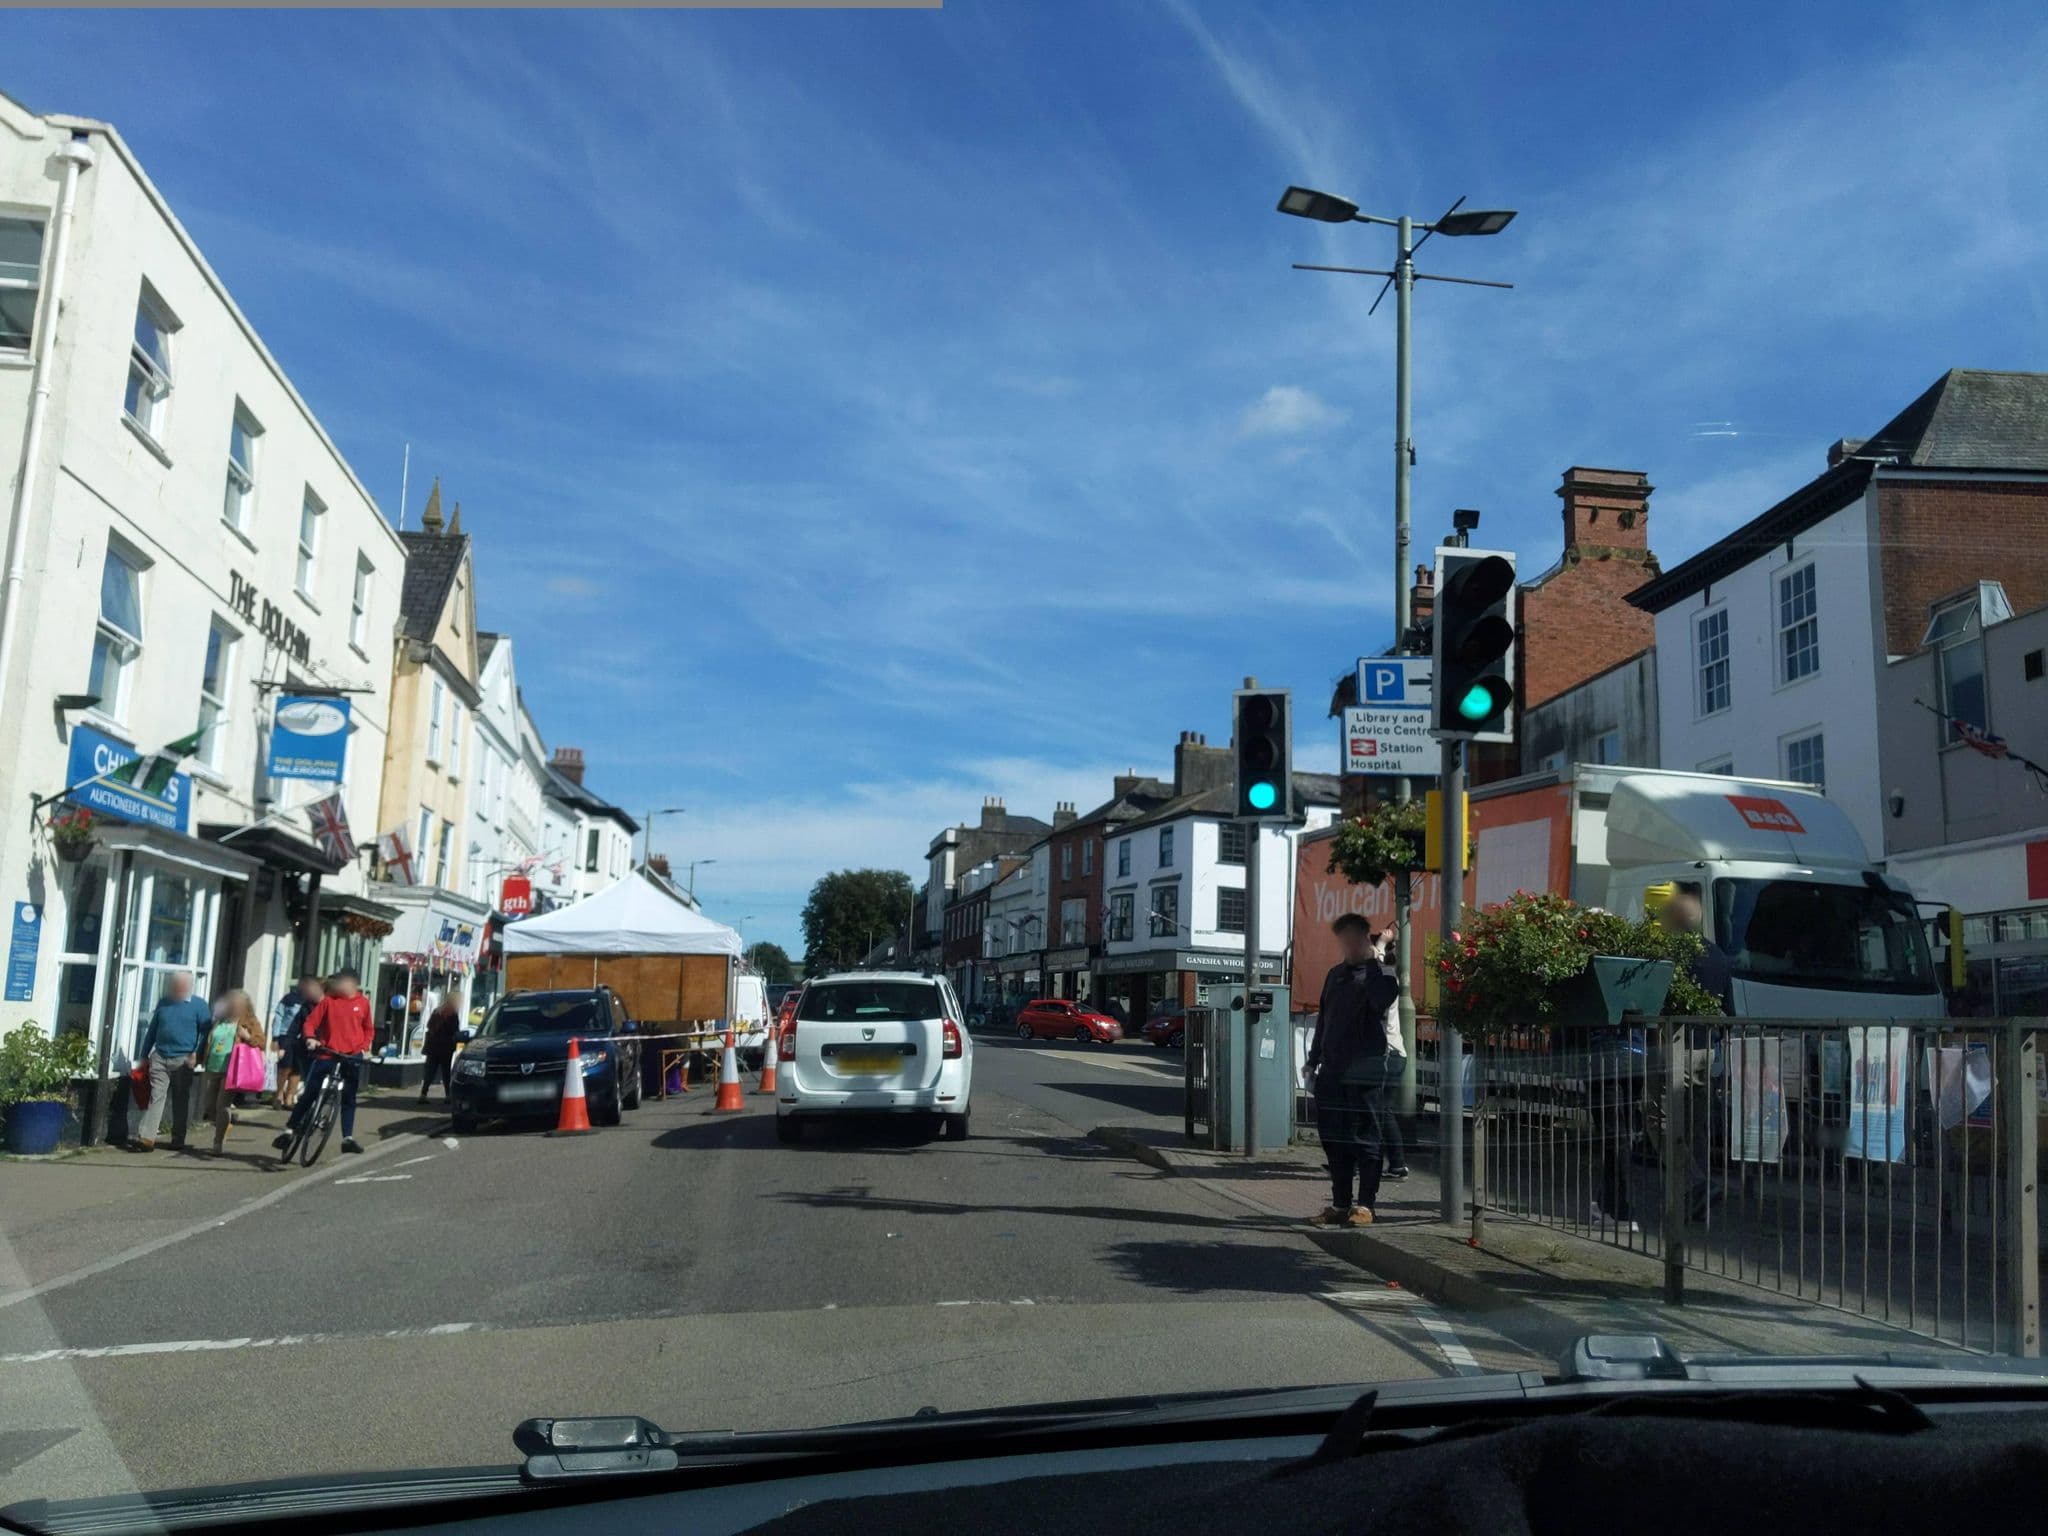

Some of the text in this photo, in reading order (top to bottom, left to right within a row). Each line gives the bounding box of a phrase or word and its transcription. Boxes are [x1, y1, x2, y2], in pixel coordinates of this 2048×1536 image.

[230, 568, 310, 667] THE DOLPHIN
[1376, 669, 1396, 695] P
[1356, 712, 1424, 724] Library and
[1350, 724, 1390, 735] Advice
[1380, 743, 1423, 753] Station
[1351, 759, 1402, 770] Hospital
[90, 788, 140, 816] AUCTIONEERS
[503, 896, 527, 911] gth
[1186, 956, 1221, 966] GANESHA
